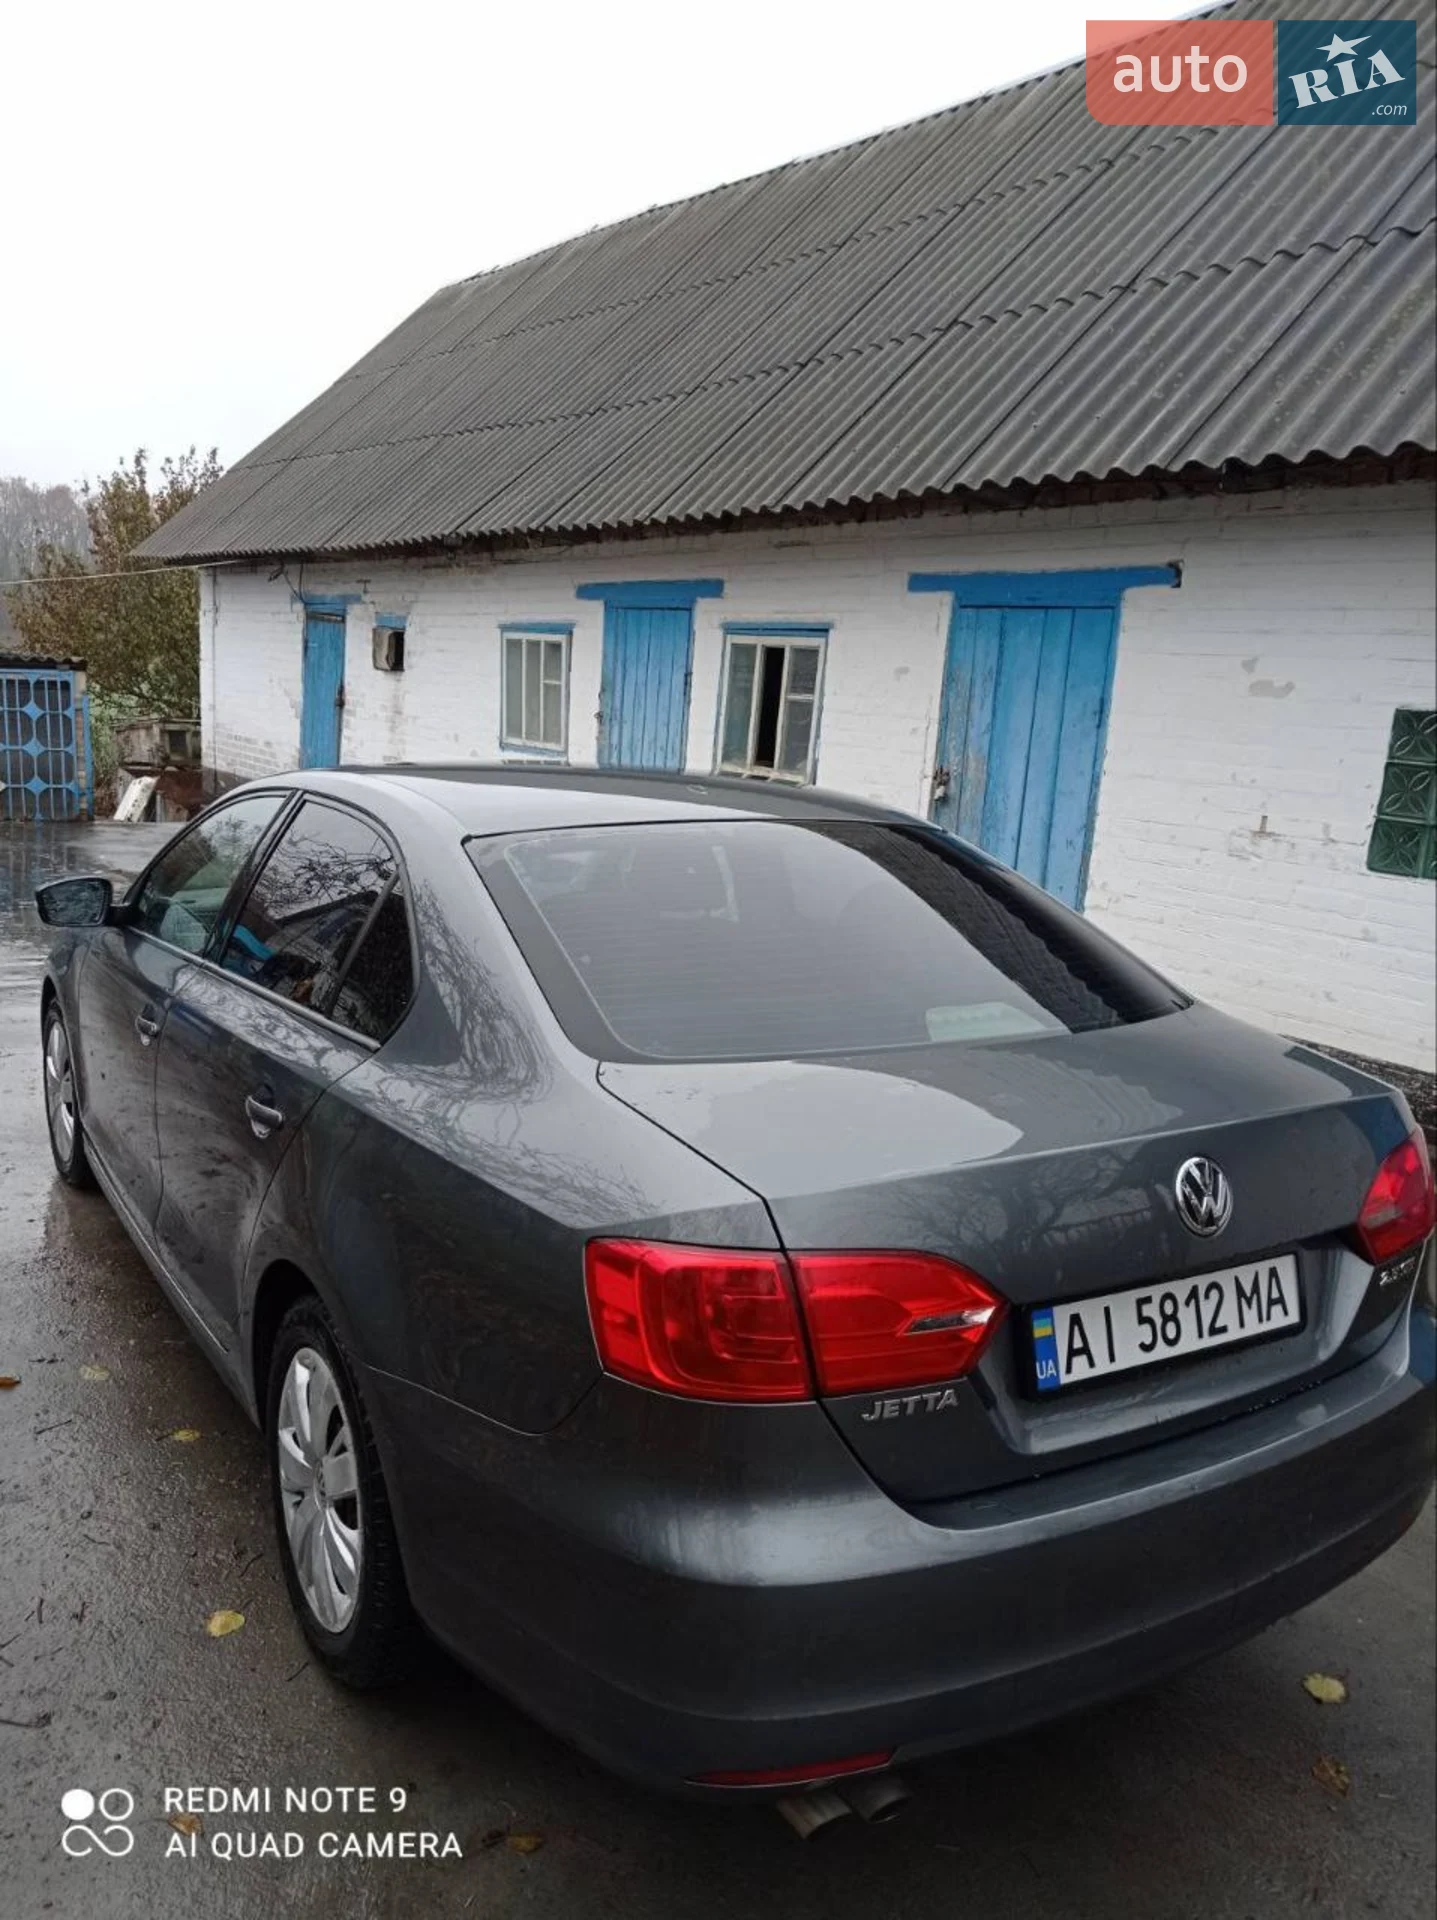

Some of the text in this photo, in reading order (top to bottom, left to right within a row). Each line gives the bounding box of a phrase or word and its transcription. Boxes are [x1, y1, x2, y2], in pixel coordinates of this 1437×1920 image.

[1064, 1266, 1289, 1375] AI 5812 MA
[1036, 1359, 1057, 1379] UA
[861, 1389, 958, 1421] JETTA
